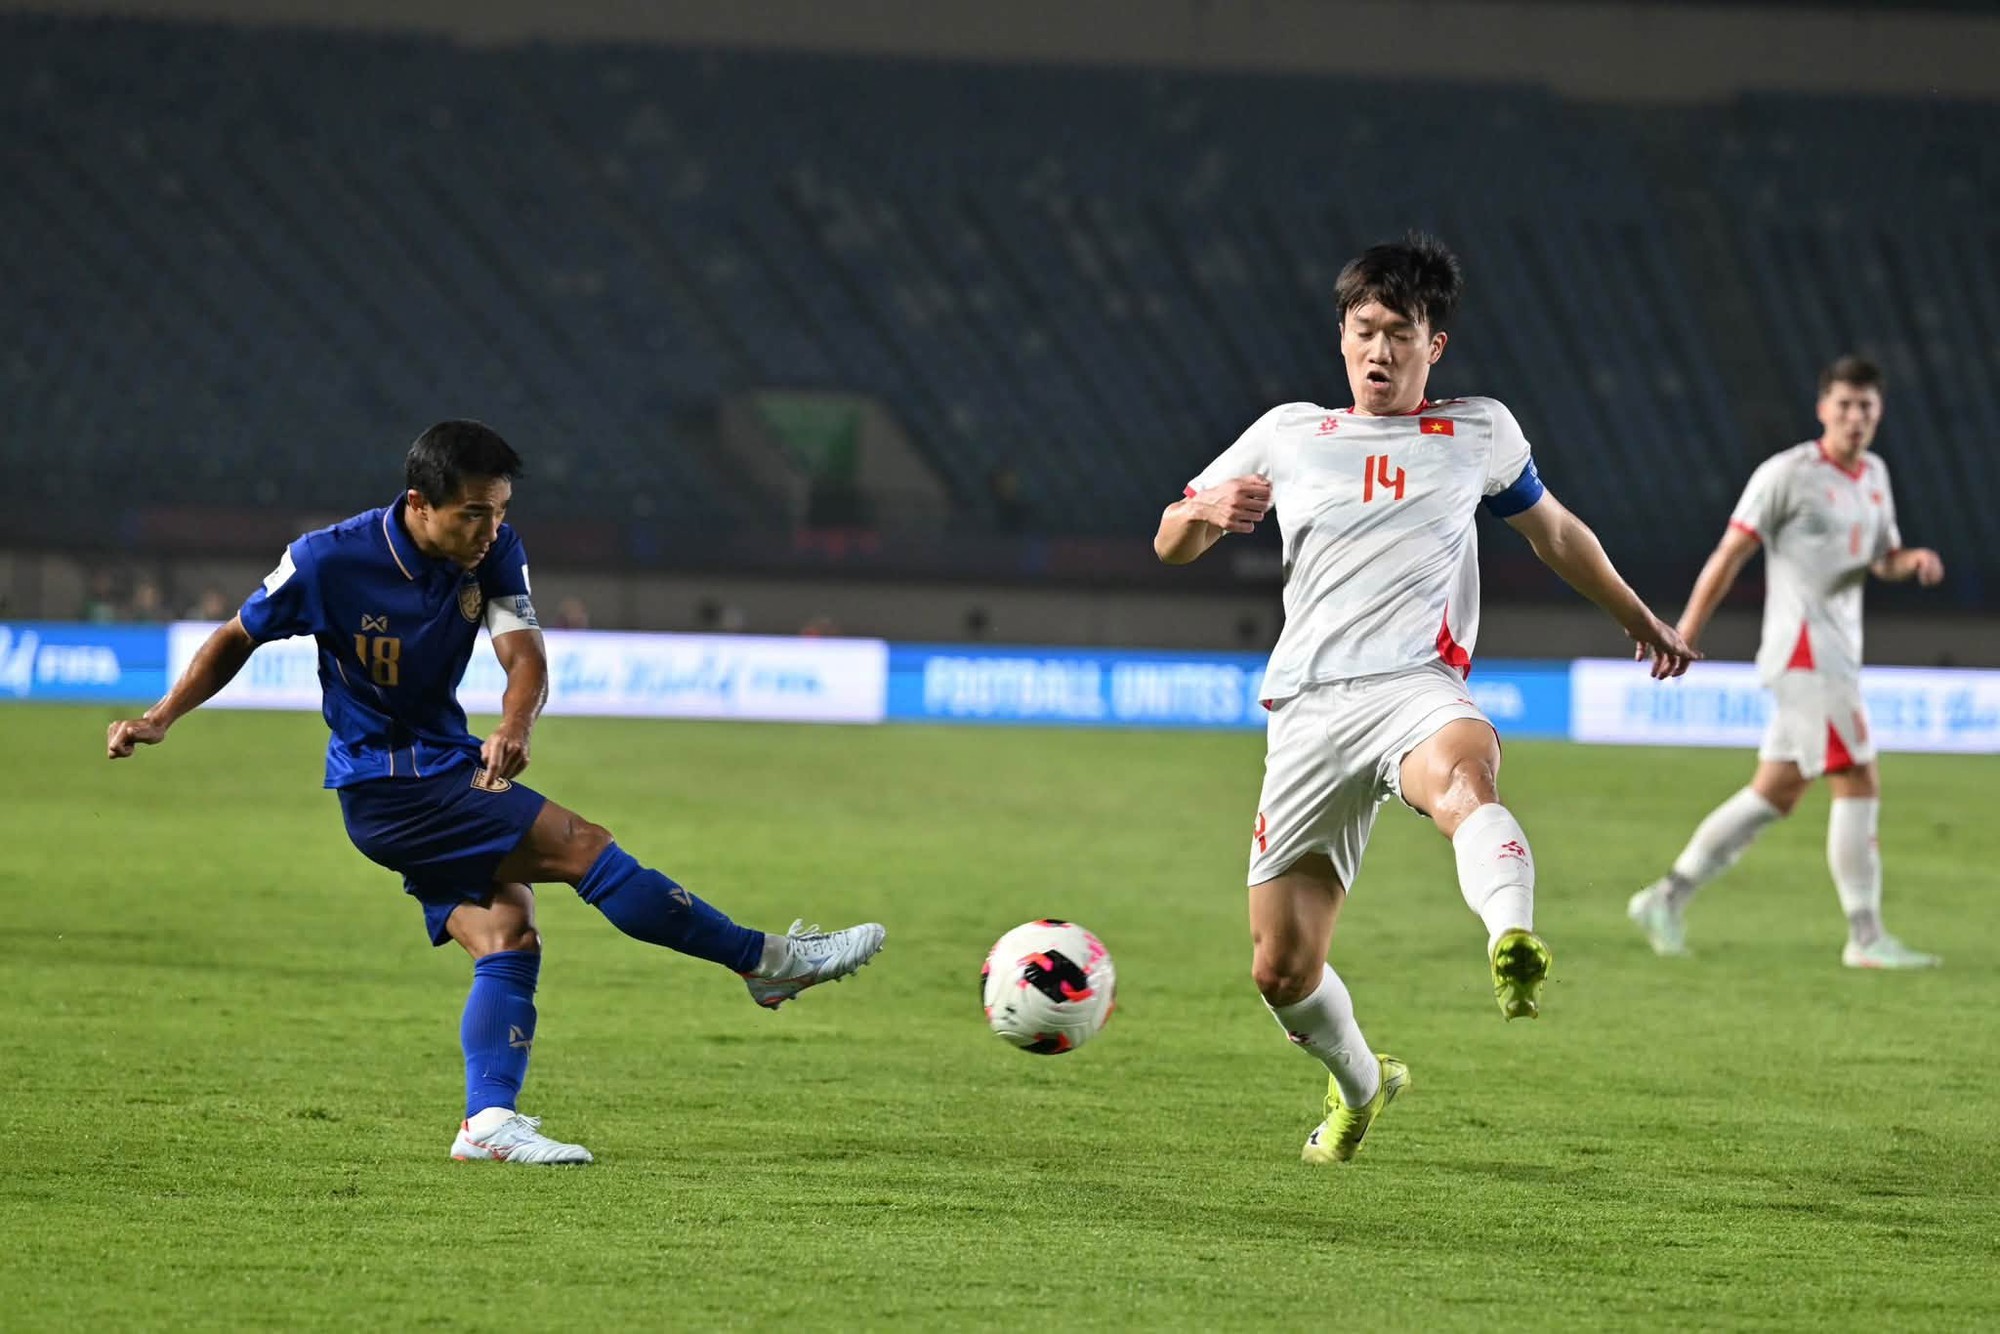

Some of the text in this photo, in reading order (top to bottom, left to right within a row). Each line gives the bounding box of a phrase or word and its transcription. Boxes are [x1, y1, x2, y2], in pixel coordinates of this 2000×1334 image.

[1363, 454, 1406, 503] 14
[353, 633, 401, 687] 18
[924, 656, 1107, 719] FOOTBALL
[1111, 661, 1244, 723] UNITES
